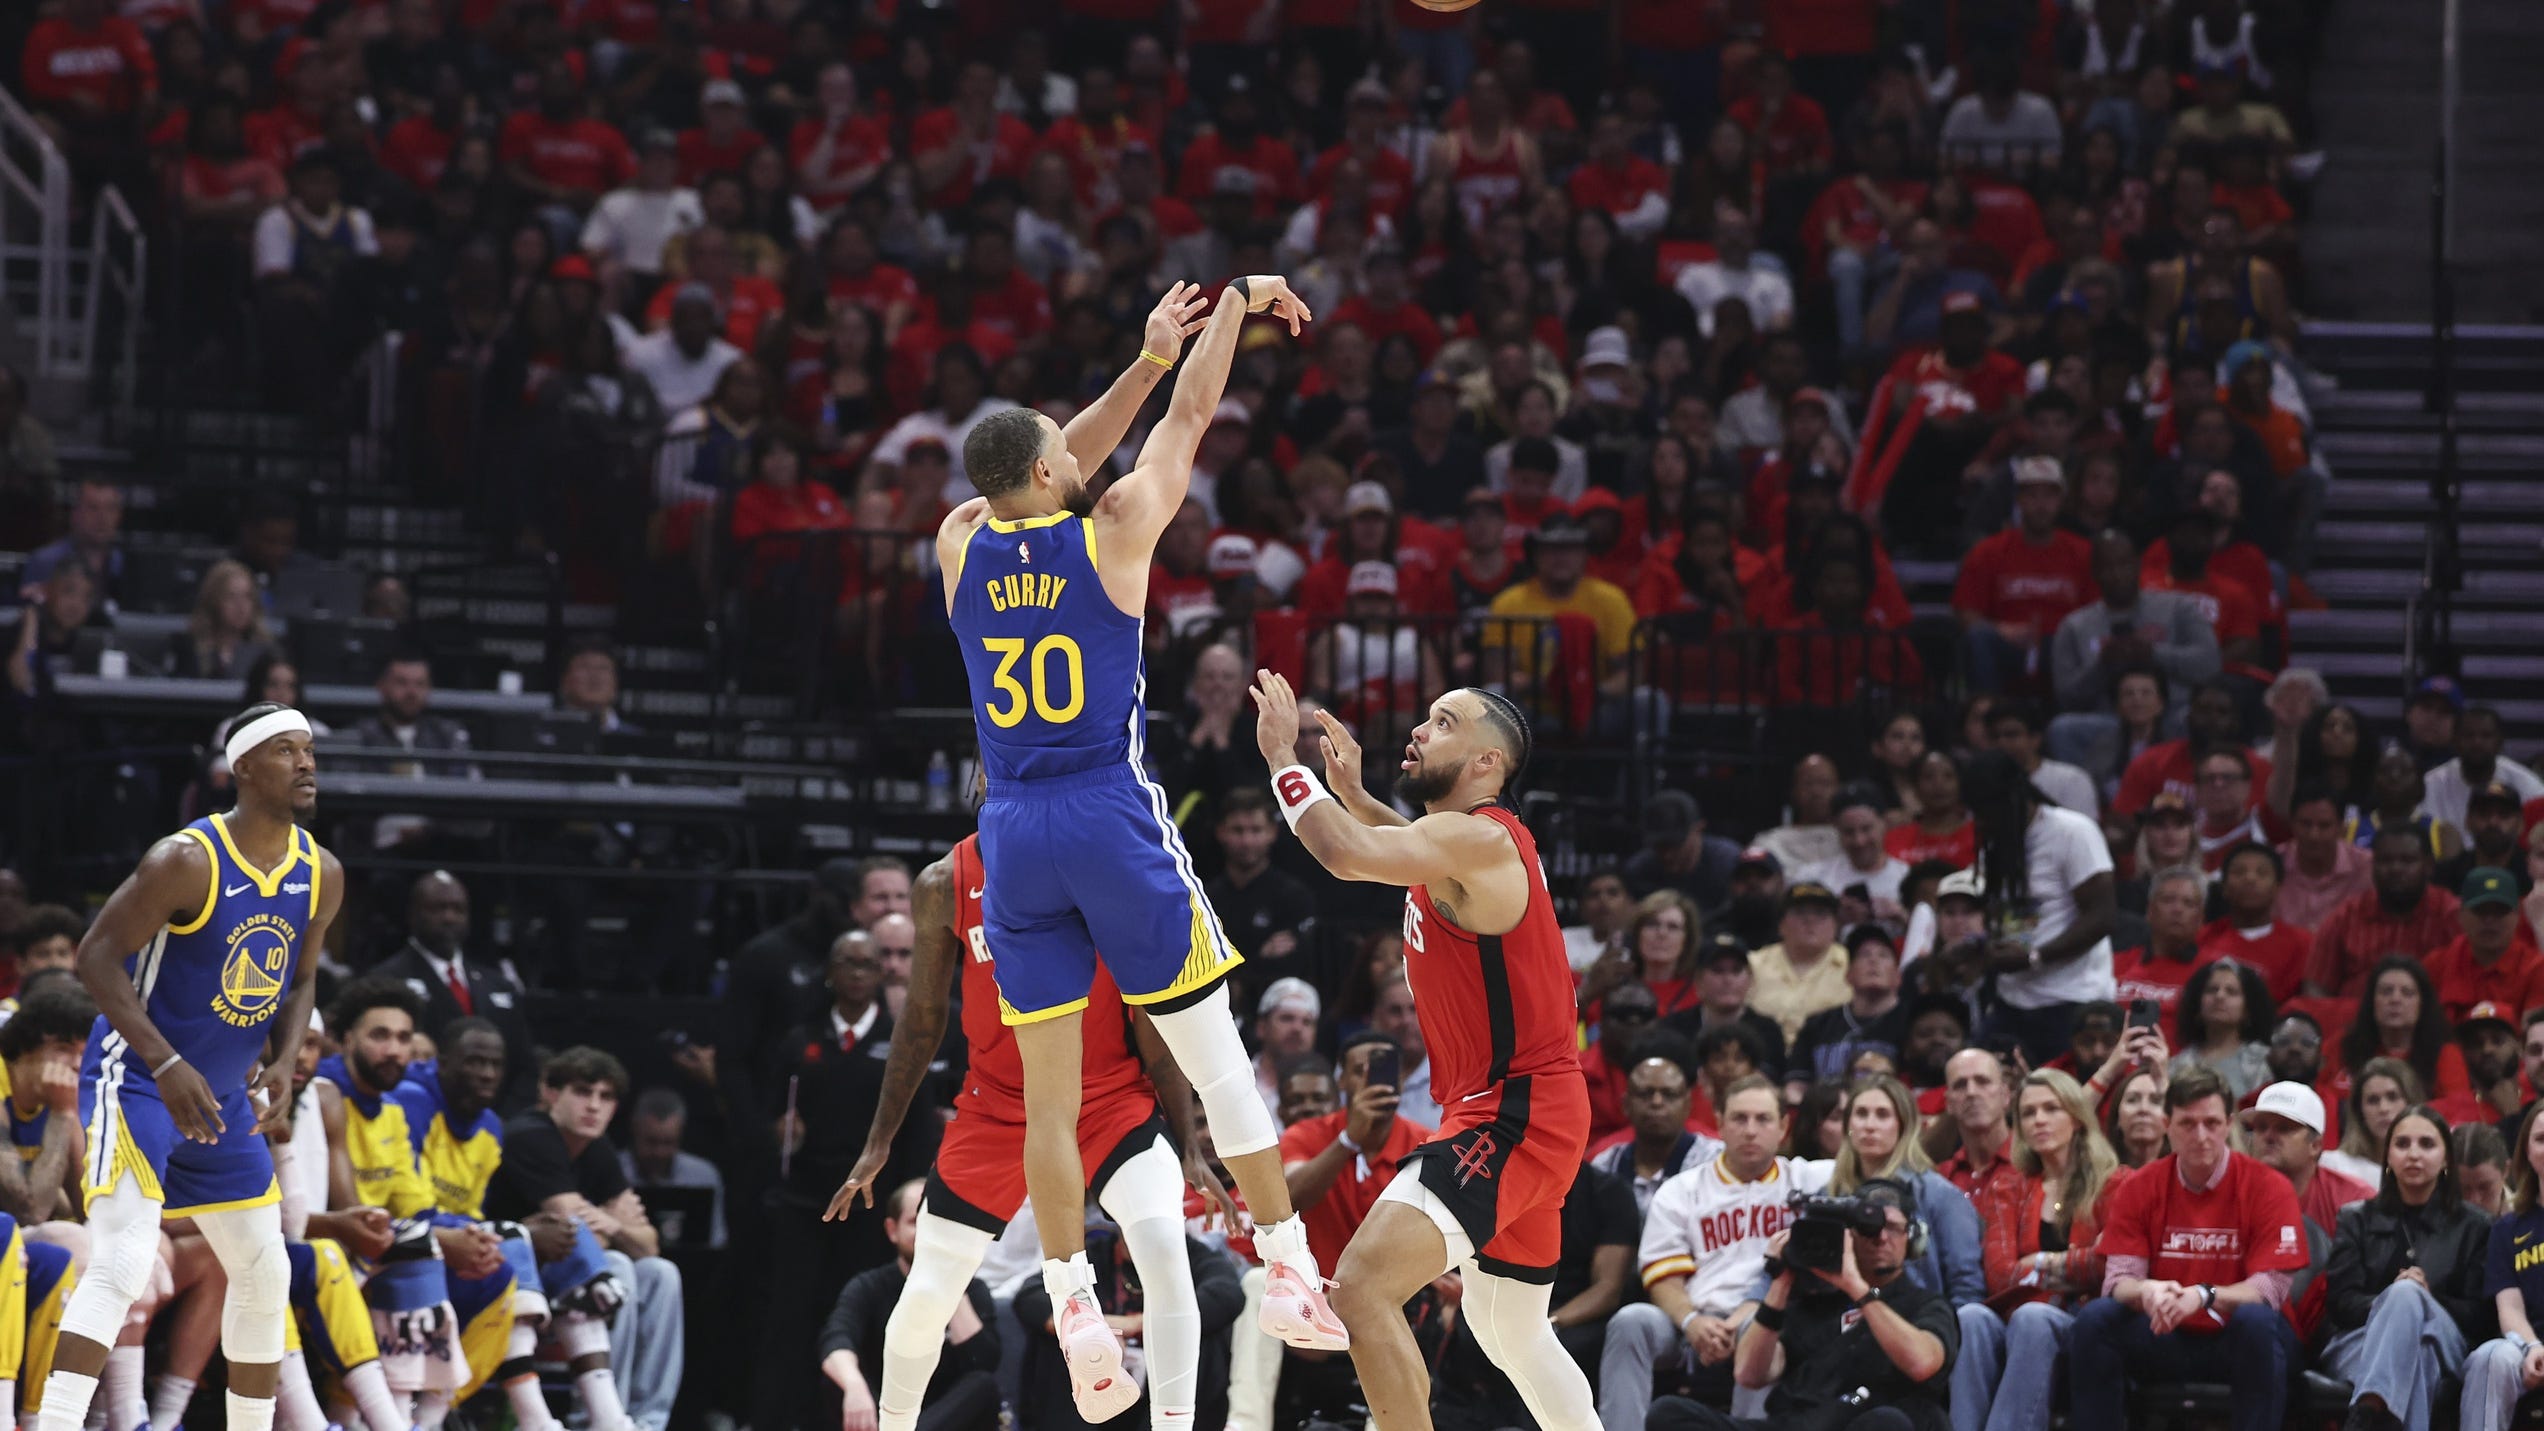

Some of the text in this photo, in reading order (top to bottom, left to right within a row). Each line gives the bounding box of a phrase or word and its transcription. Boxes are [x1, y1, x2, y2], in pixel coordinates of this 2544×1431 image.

[986, 573, 1068, 612] CURRY
[982, 634, 1085, 728] 30
[1277, 771, 1311, 807] 6
[226, 913, 297, 944] GOLDEN STATE
[265, 947, 284, 971] 10
